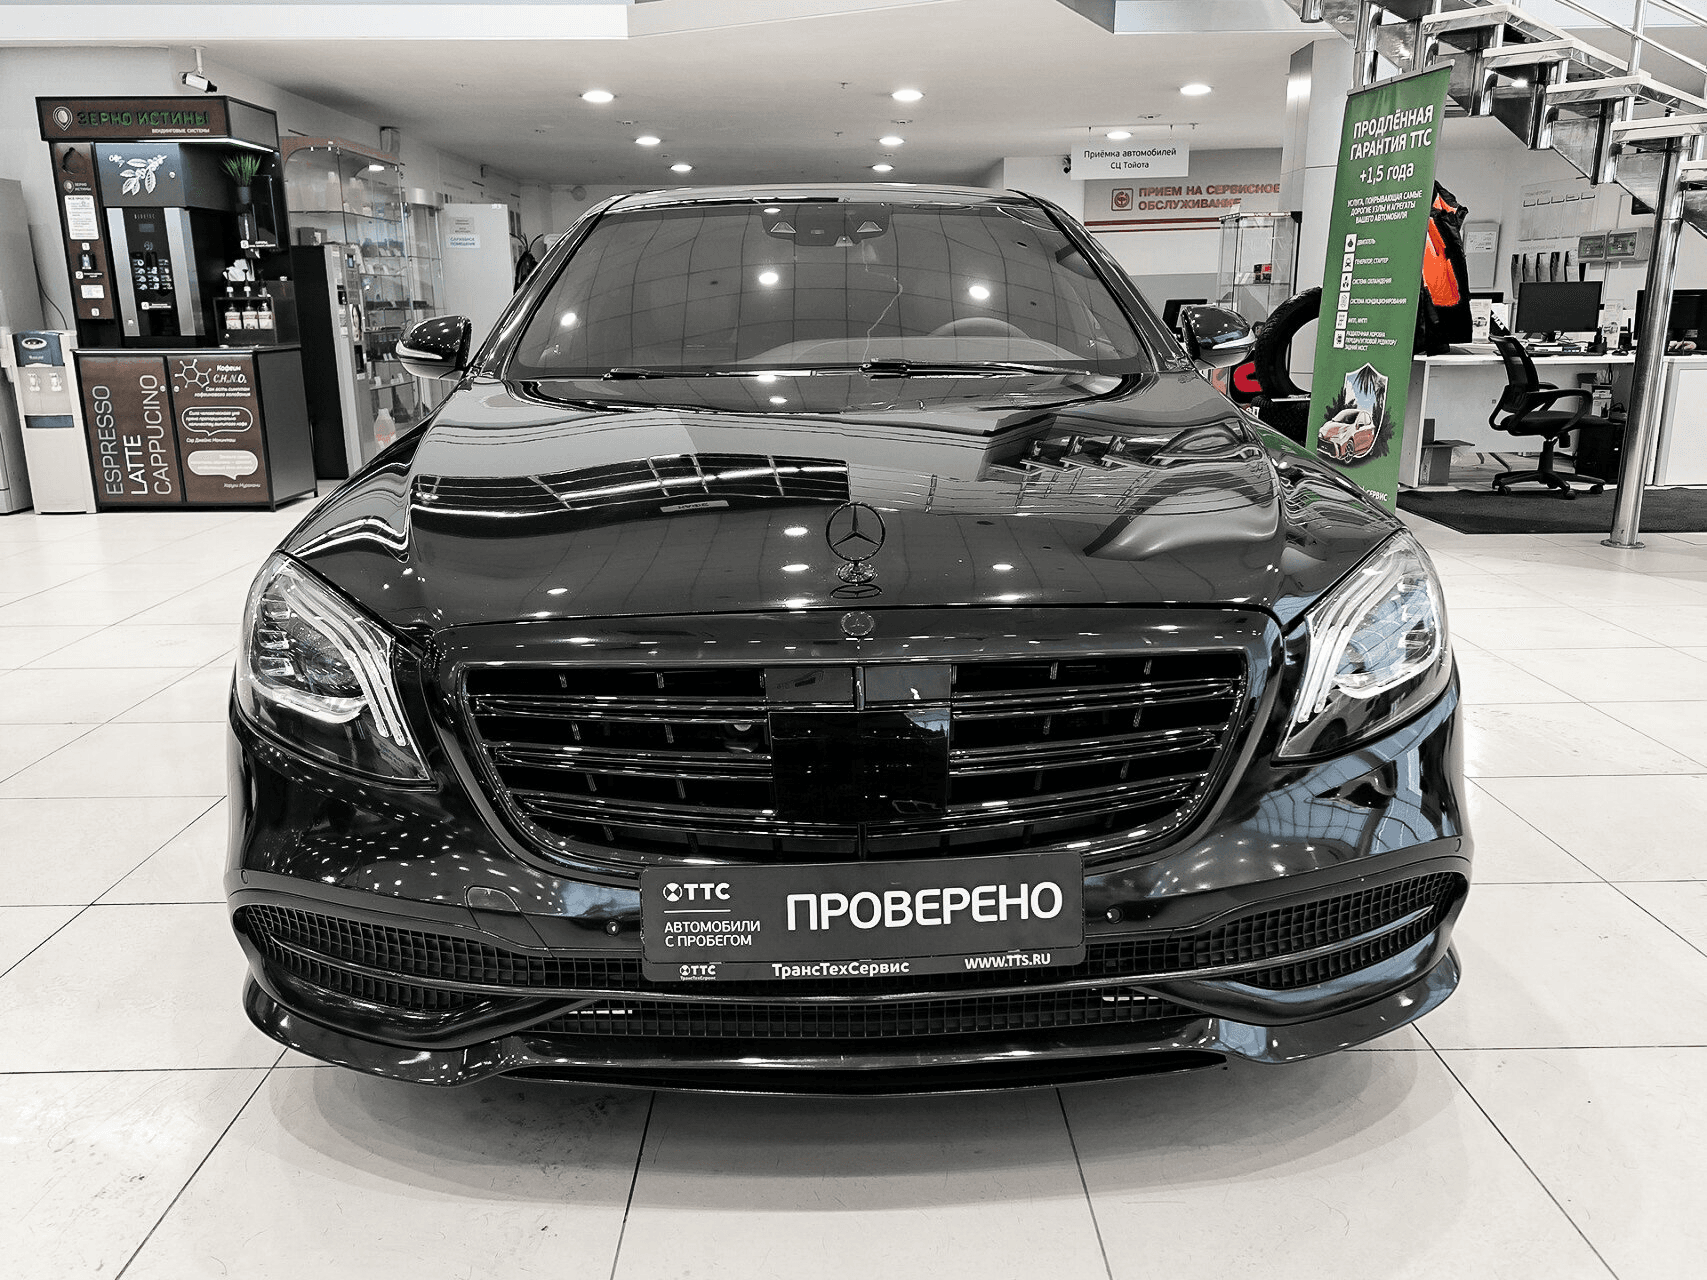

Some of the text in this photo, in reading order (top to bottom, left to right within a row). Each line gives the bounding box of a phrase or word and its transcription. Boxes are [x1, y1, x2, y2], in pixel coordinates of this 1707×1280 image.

[77, 111, 209, 127] ЗЕРНО ИСТИНЫ
[1353, 104, 1434, 139] ПРОДЛЁННАЯ
[1084, 148, 1177, 159] Приёмка автомобилей
[1350, 128, 1432, 161] ГАРАНТИЯ ТТС
[1110, 162, 1122, 170] СЦ
[1360, 162, 1414, 185] +1,5 года
[1138, 183, 1281, 197] ПРИЕМ НА СЕРВИСНОЕ
[1138, 197, 1242, 210] ОБСЛУЖИВАНИЕ
[92, 385, 124, 495] ESPRESSO
[139, 374, 172, 495] CAPPUCINO
[123, 434, 149, 495] LATTE
[683, 882, 731, 901] ТТС
[786, 881, 1064, 931] ПРОВЕРЕНО
[664, 920, 761, 933] АВТОМОБИЛИ
[665, 934, 752, 948] С ПРОБЕГОМ
[690, 965, 716, 975] ТТС
[772, 961, 910, 979] ТрансТехСервис
[964, 952, 1051, 970] WWW.TTS.RU
